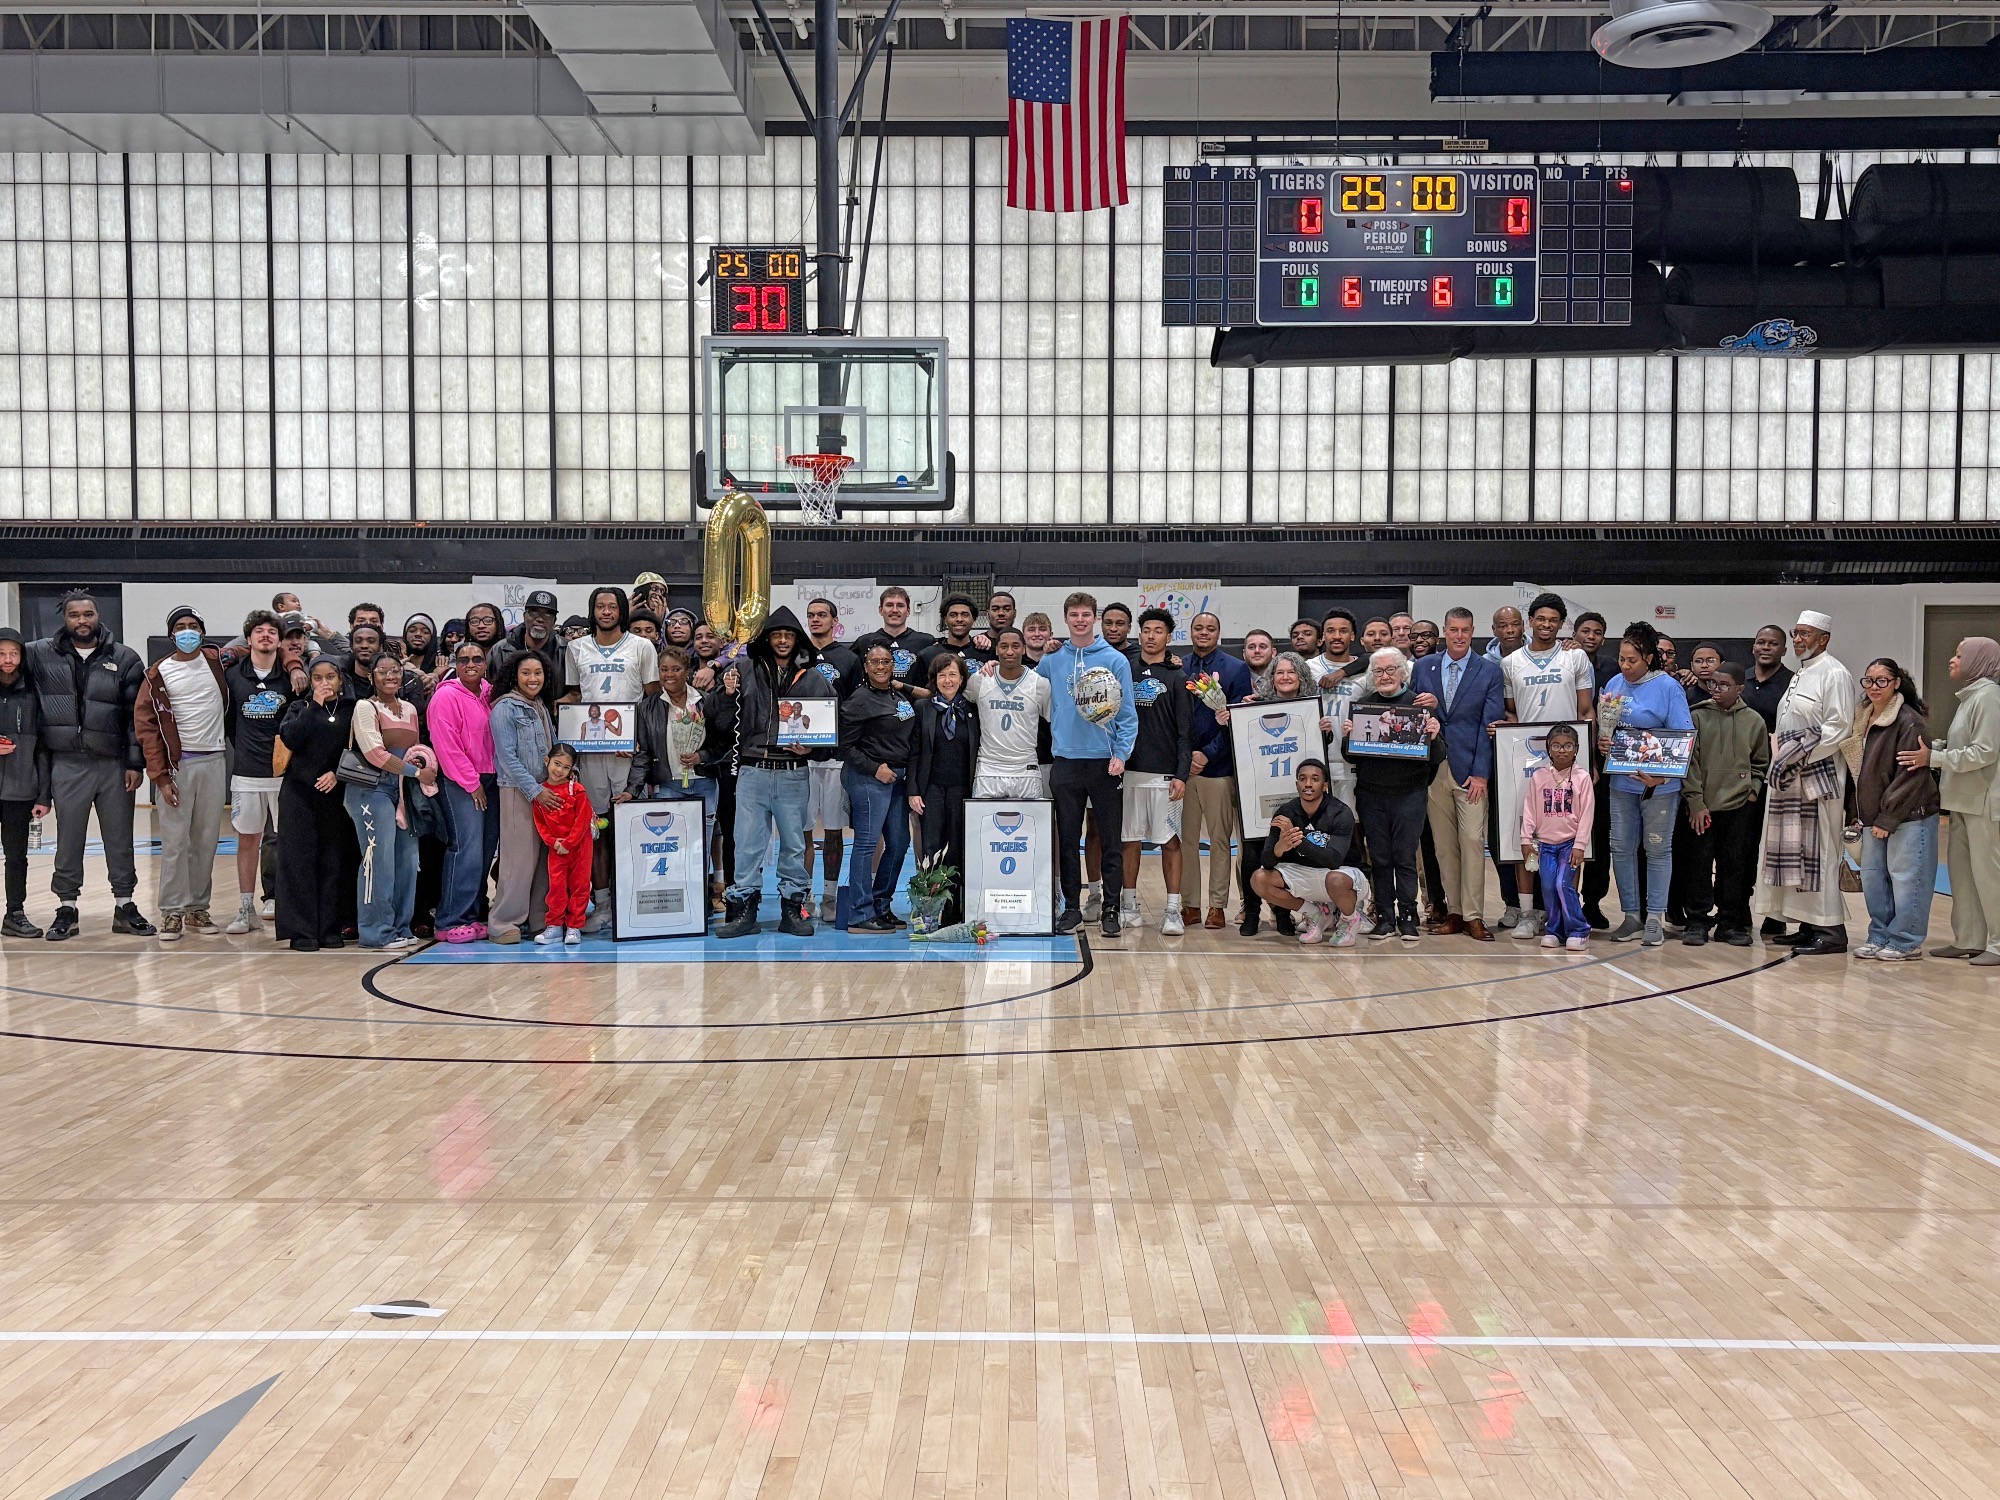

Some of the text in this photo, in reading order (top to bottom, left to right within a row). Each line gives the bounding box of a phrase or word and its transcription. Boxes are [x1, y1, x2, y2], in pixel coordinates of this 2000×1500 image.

[1174, 168, 1191, 180] NO
[1210, 168, 1218, 179] F
[1234, 168, 1257, 180] PTS
[1545, 167, 1563, 179] NO
[1582, 167, 1590, 179] F
[1605, 167, 1628, 179] PTS
[1270, 174, 1325, 190] TIGERS
[1470, 174, 1534, 191] VISITOR
[1301, 199, 1321, 233] 0
[1507, 198, 1528, 233] 0
[1374, 220, 1398, 230] POSS
[1363, 232, 1408, 244] PERIOD
[1289, 241, 1329, 253] BONUS
[1466, 241, 1508, 253] BONUS
[718, 254, 748, 277] 25
[769, 254, 799, 277] 00
[1282, 263, 1319, 276] FOULS
[1475, 262, 1513, 275] FOULS
[1301, 278, 1317, 306] 0
[1344, 278, 1360, 306] 6
[1369, 279, 1428, 292] TIMEOUTS
[1434, 277, 1449, 305] 6
[1495, 277, 1512, 305] 0
[1383, 293, 1412, 305] LEFT
[731, 286, 786, 330] 30
[1515, 586, 1535, 599] The
[588, 663, 625, 674] TIGERS
[600, 675, 612, 694] 4
[1523, 673, 1563, 687] TIGERS
[1538, 688, 1548, 707] 1
[988, 699, 1025, 711] TIGERS
[1325, 699, 1342, 717] 11
[1000, 713, 1012, 732] 0
[1259, 741, 1299, 756] TIGERS
[1268, 756, 1292, 778] 11
[639, 842, 679, 854] TIGERS
[989, 841, 1028, 853] TIGERS
[651, 857, 669, 876] 4
[999, 856, 1017, 875] 0
